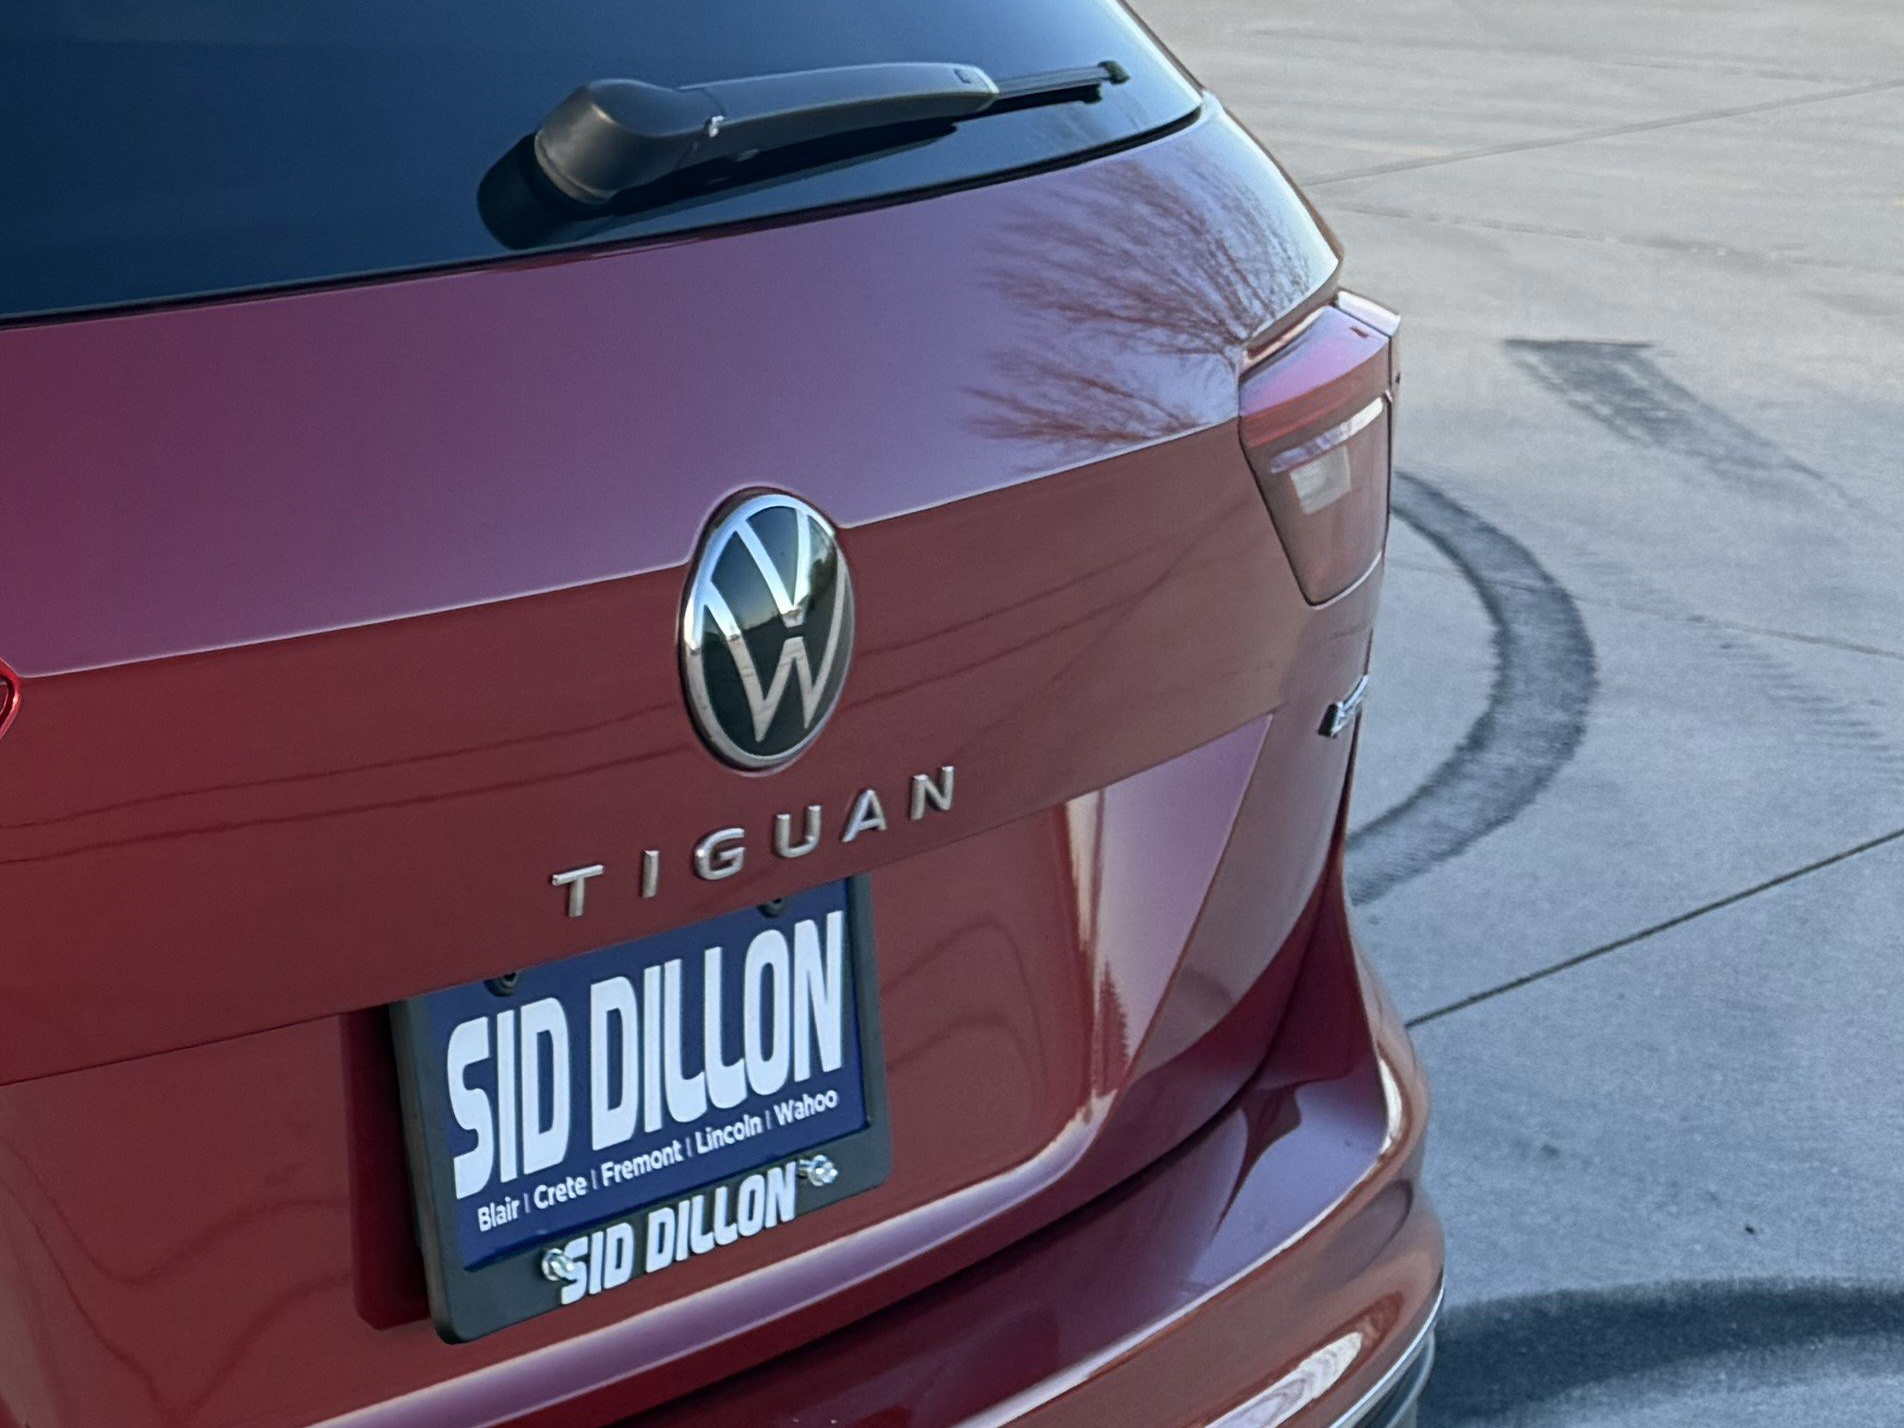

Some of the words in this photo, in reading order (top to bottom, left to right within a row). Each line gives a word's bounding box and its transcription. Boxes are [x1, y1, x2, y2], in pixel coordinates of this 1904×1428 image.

[552, 765, 954, 918] TIGUAN
[447, 997, 571, 1199] SID
[591, 911, 844, 1150] DILLON
[478, 1200, 520, 1232] Blair
[534, 1175, 587, 1210] Crete
[601, 1140, 683, 1187] Fremont
[696, 1114, 764, 1154] Lincoln
[773, 1090, 838, 1126] Wahoo
[560, 1223, 634, 1304] SID
[646, 1161, 797, 1273] DILLON
